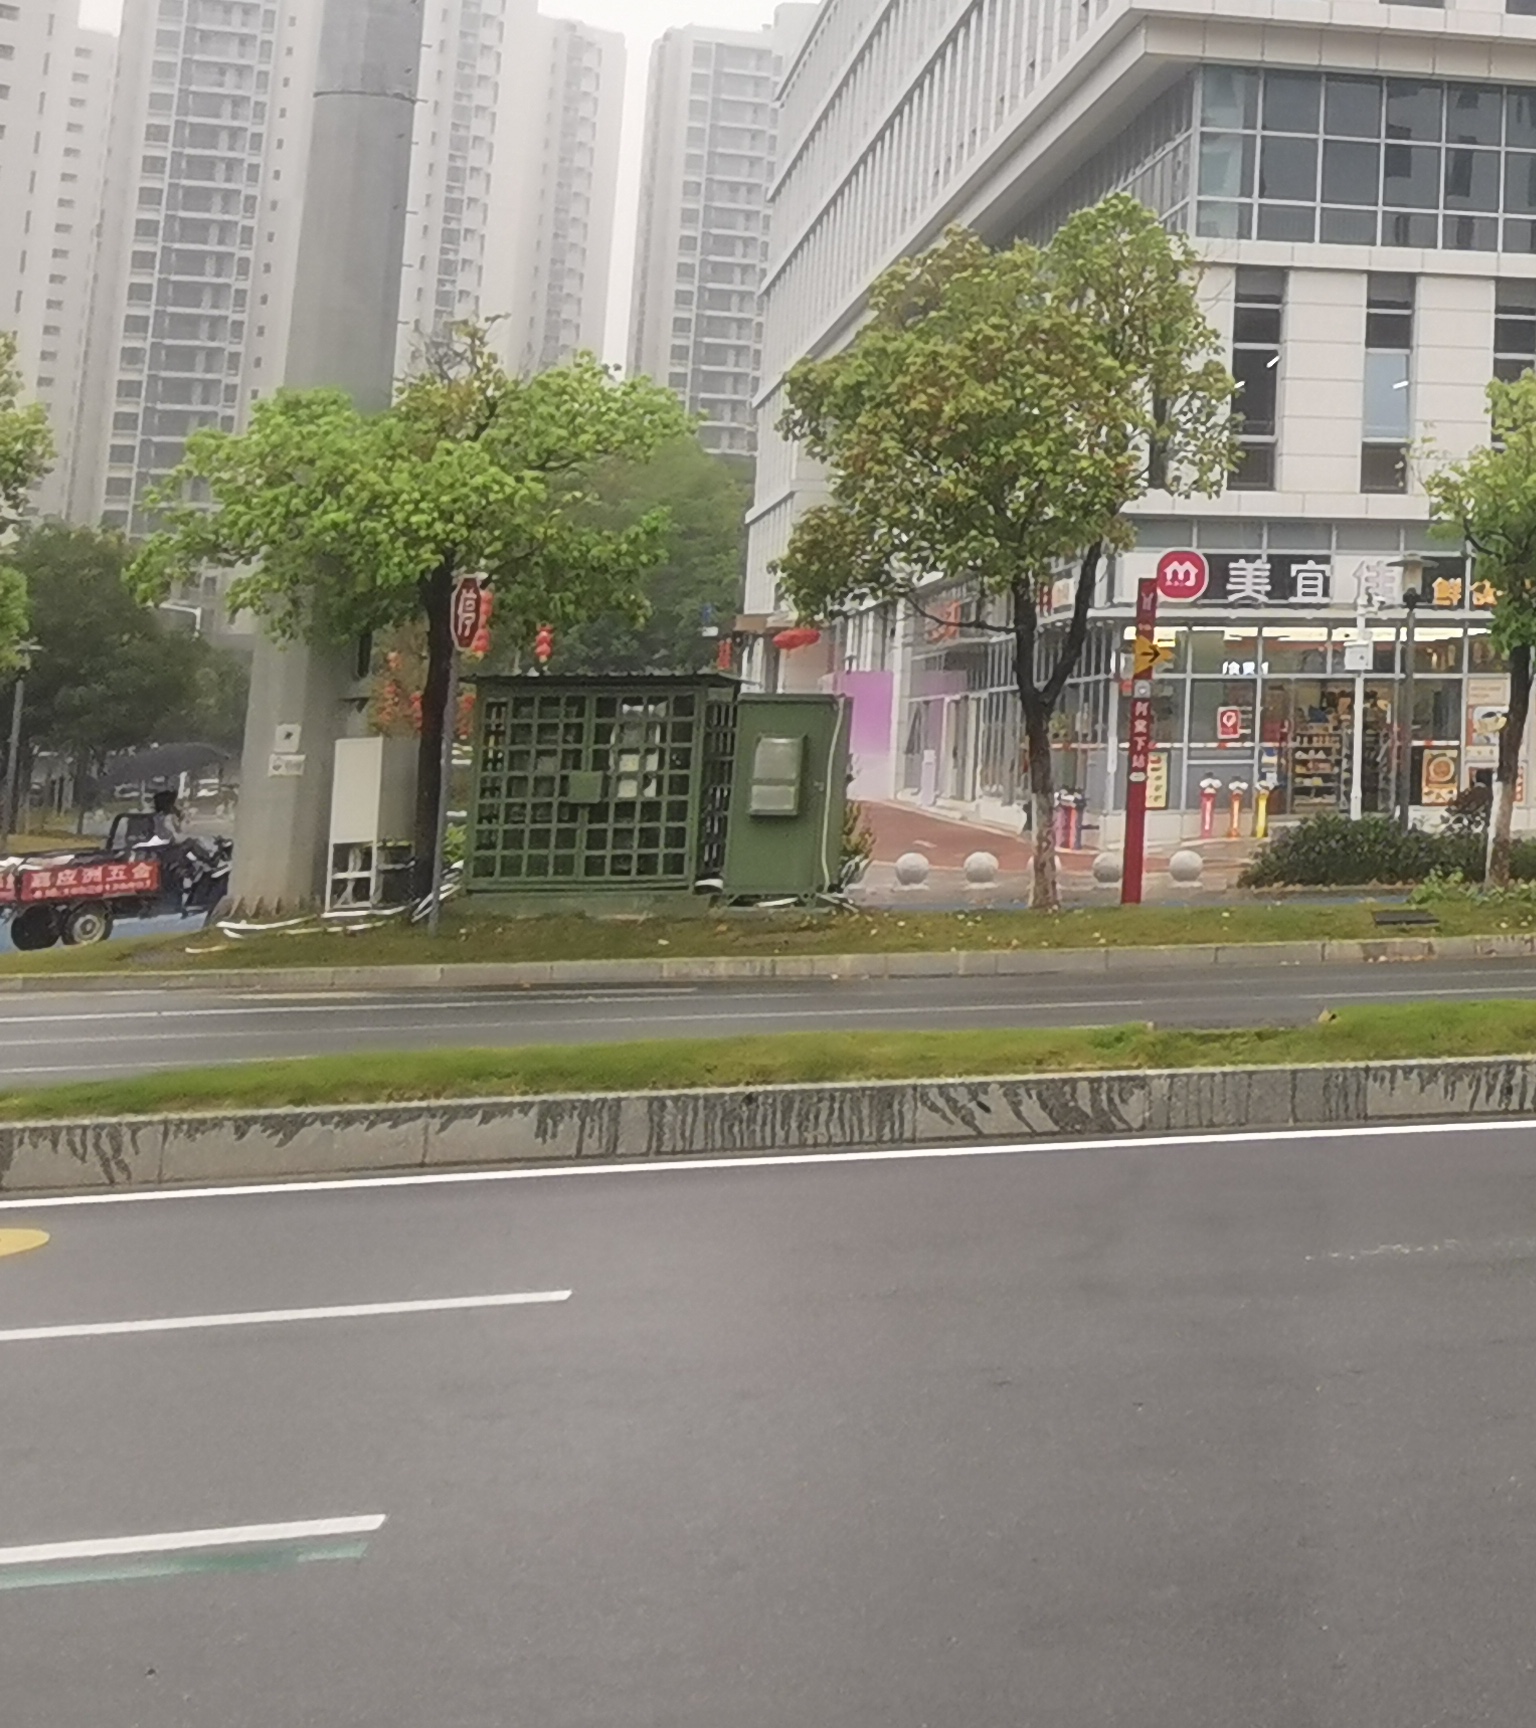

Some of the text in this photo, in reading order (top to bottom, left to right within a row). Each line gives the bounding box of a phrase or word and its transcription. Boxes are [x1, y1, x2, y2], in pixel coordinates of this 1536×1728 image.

[1226, 558, 1404, 605] 美宜佳
[457, 587, 478, 637] 停
